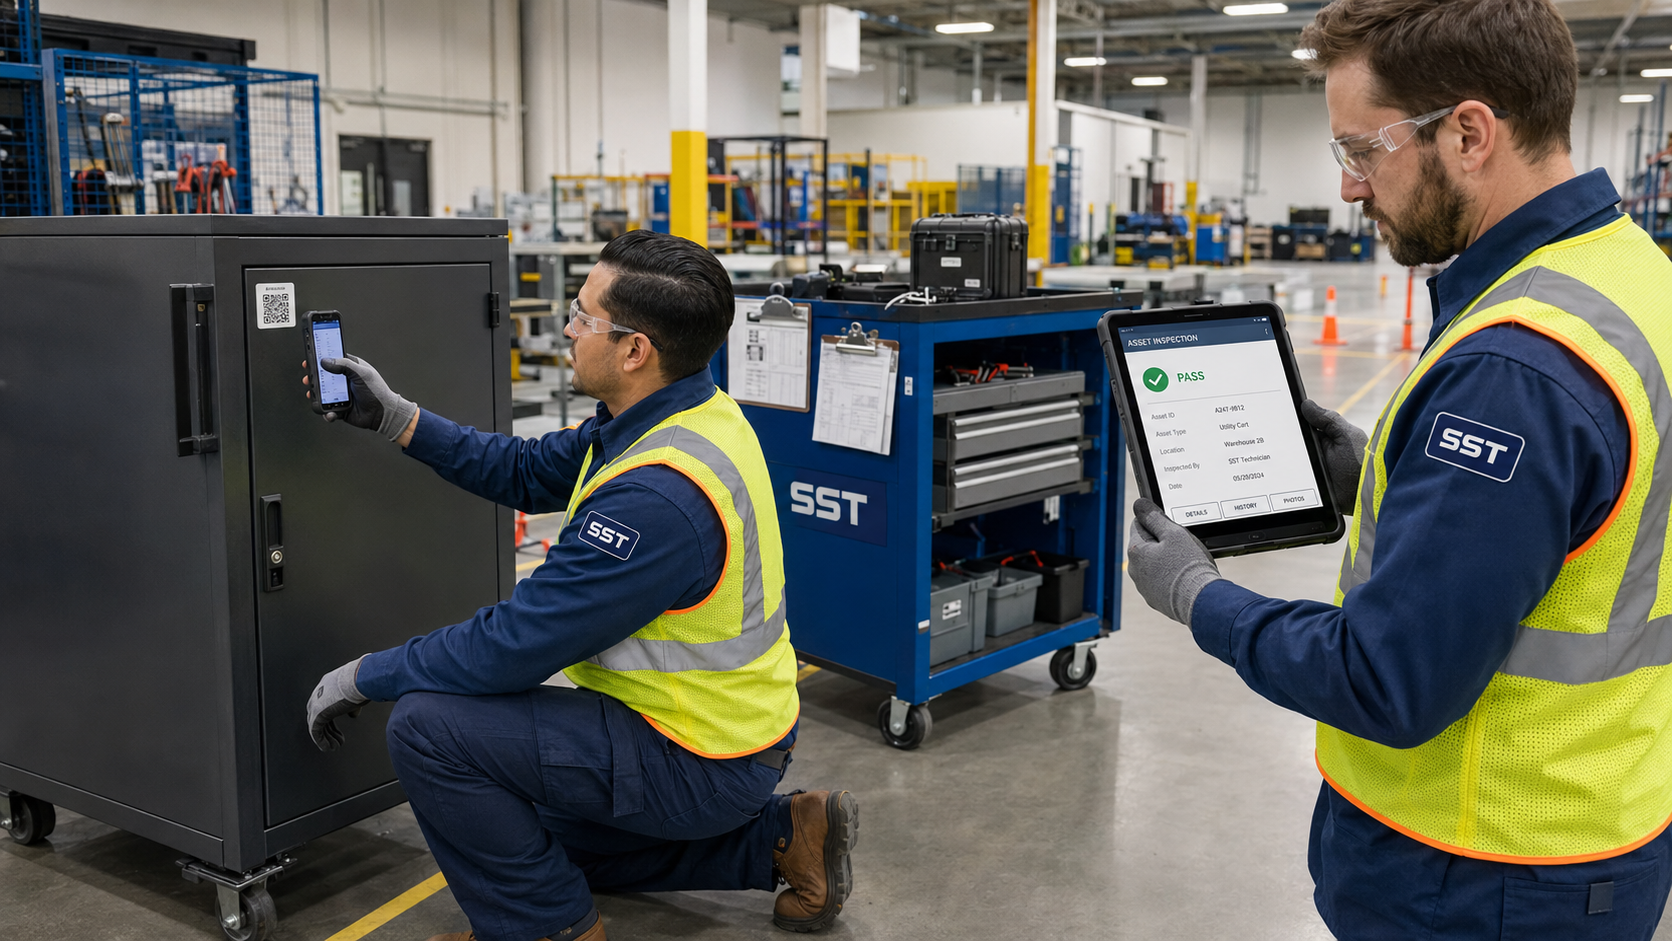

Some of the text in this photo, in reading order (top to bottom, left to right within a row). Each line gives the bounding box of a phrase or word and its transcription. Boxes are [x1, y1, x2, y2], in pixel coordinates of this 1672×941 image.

[1127, 334, 1199, 347] ASSET INSPECTION
[1177, 371, 1205, 383] PASS
[1219, 421, 1250, 431] Utility Cart
[1173, 428, 1187, 437] Type
[1223, 439, 1256, 448] Warehouse
[1439, 428, 1508, 464] SST
[1159, 446, 1185, 455] Location
[1228, 454, 1271, 465] SST Technician
[1164, 462, 1201, 473] Inspected By
[790, 481, 868, 526] SST
[1283, 496, 1305, 504] PHOTOS
[1234, 502, 1257, 511] HISTORY
[1185, 509, 1208, 518] DETAILS
[587, 520, 630, 549] SST
